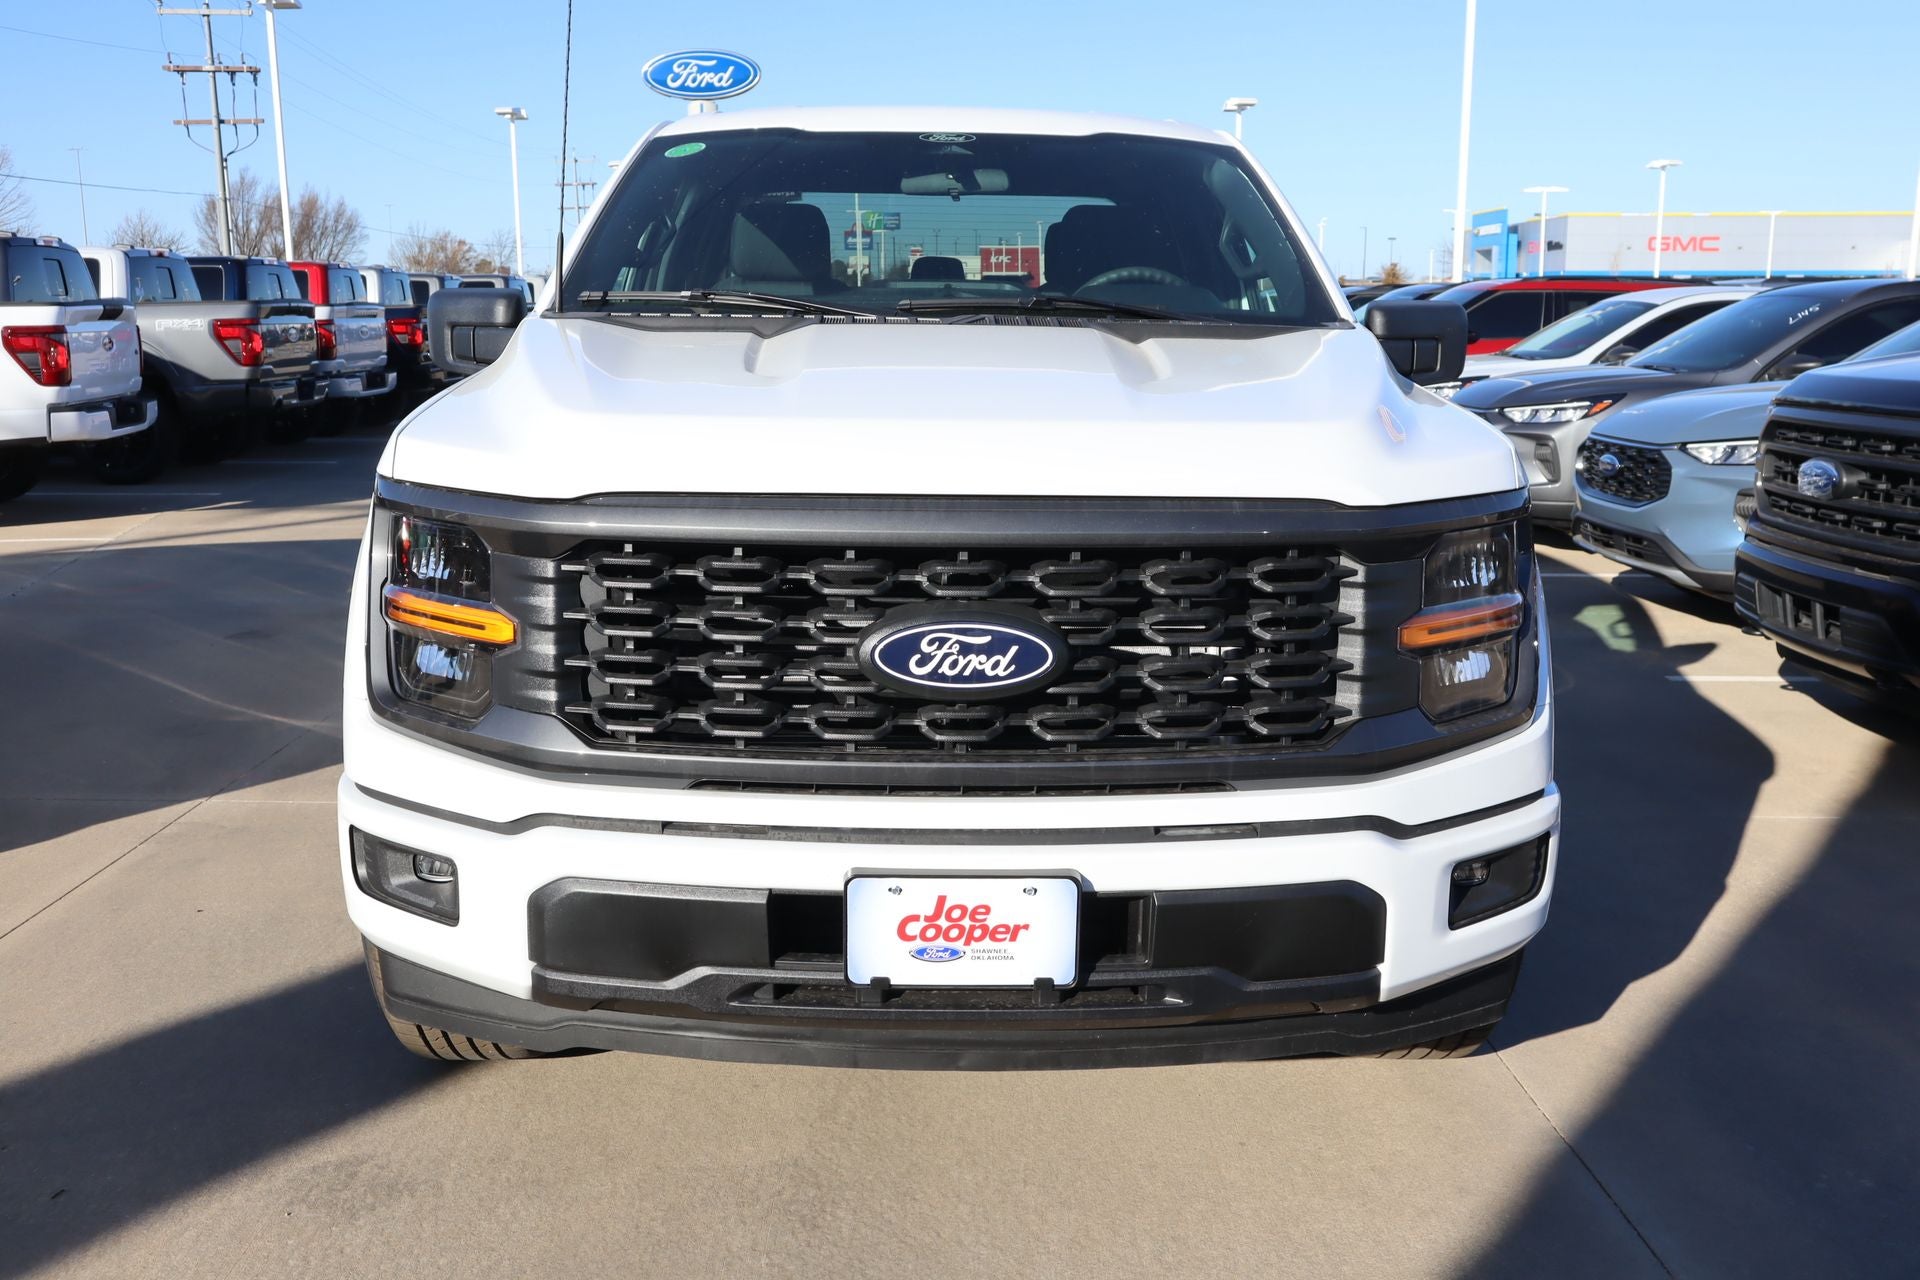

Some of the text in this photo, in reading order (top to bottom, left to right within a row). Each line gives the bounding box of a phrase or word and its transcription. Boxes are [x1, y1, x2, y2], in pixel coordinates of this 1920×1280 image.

[667, 58, 735, 88] Ford
[1647, 236, 1721, 252] GMC
[155, 318, 205, 331] FX4
[908, 632, 1019, 677] Ford
[923, 895, 992, 923] Joe
[896, 914, 1031, 946] Cooper
[923, 947, 951, 959] Ford
